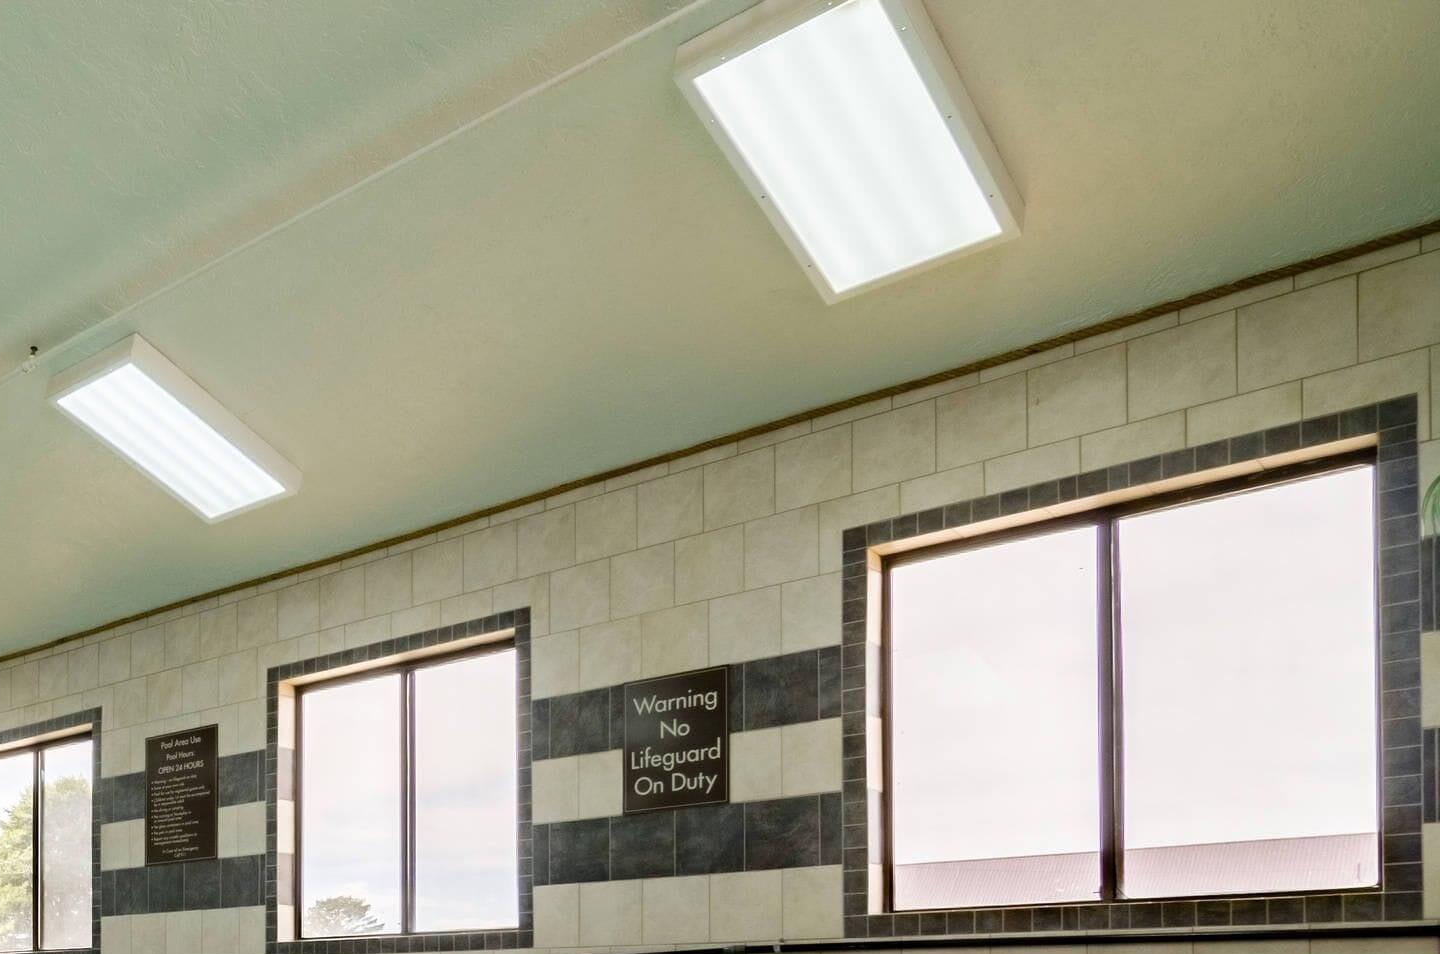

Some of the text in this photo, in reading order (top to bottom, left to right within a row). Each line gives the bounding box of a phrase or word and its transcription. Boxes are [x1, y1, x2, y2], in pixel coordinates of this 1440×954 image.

[633, 689, 718, 715] Warning
[659, 718, 690, 739] No
[160, 735, 202, 750] Pool Area Use
[631, 737, 721, 771] Lifeguard
[158, 765, 175, 775] OPEN
[183, 759, 204, 770] HOURS
[634, 772, 718, 796] On Duty
